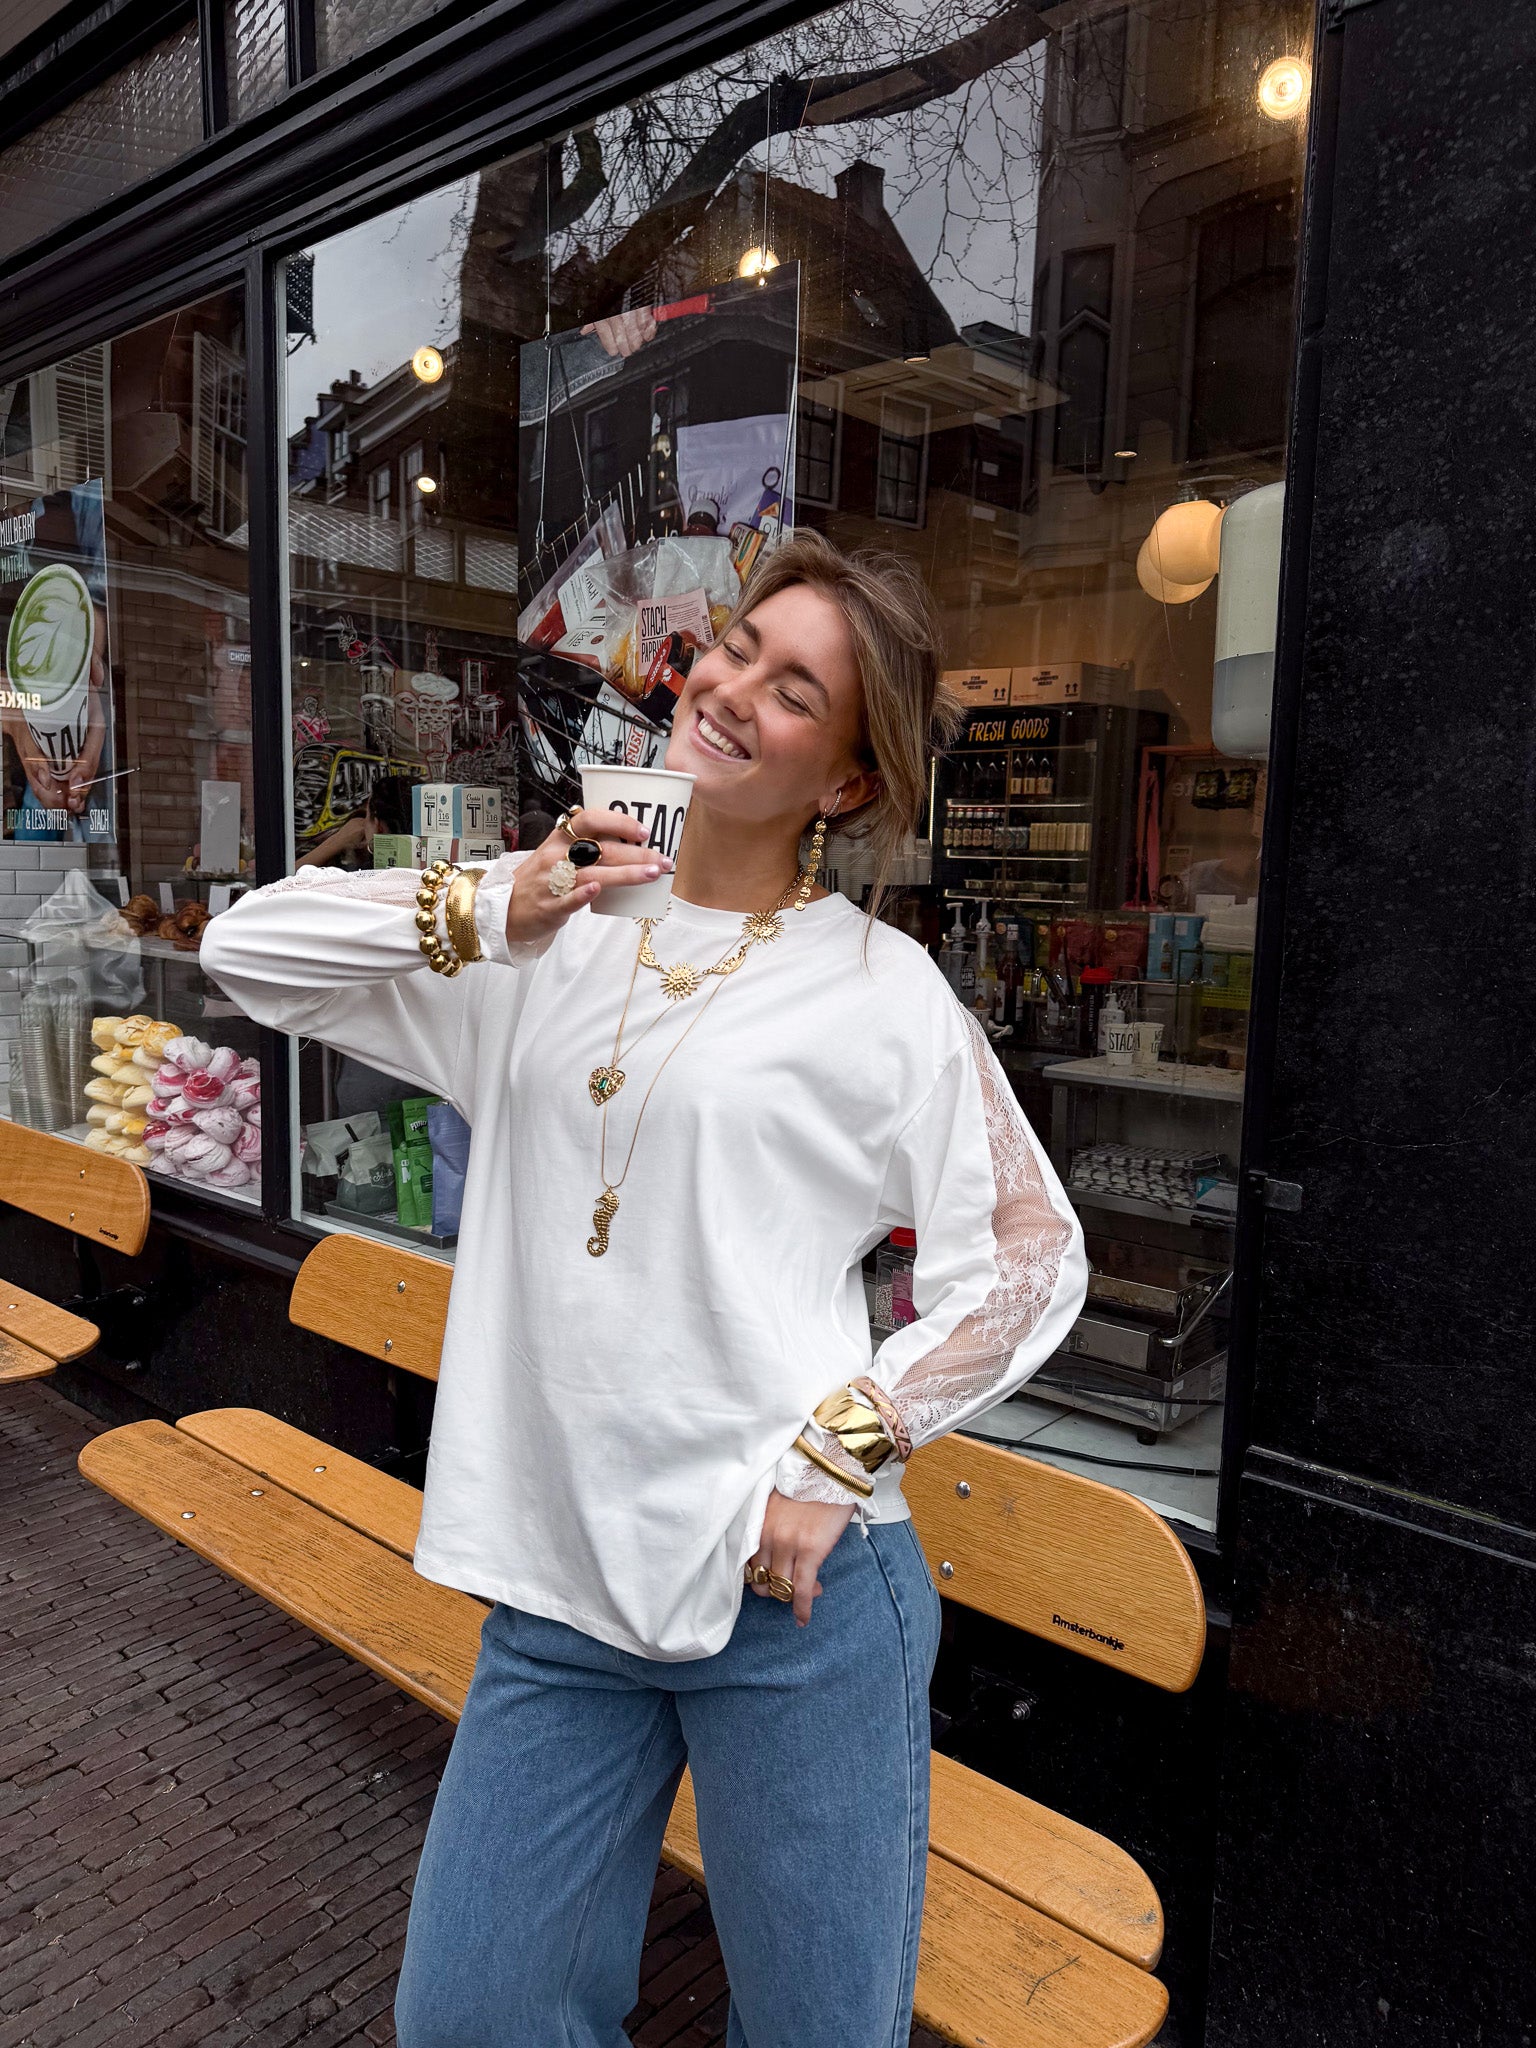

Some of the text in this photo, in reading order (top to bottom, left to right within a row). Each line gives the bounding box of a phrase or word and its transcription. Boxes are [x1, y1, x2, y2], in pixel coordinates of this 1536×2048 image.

[0, 510, 36, 547] MULBERRY
[1, 553, 29, 584] MATCHA
[641, 605, 668, 637] STACH
[968, 717, 1050, 742] FRESH GOODS
[31, 809, 47, 830] LESS
[47, 809, 68, 831] BITTER
[89, 809, 109, 831] STACH
